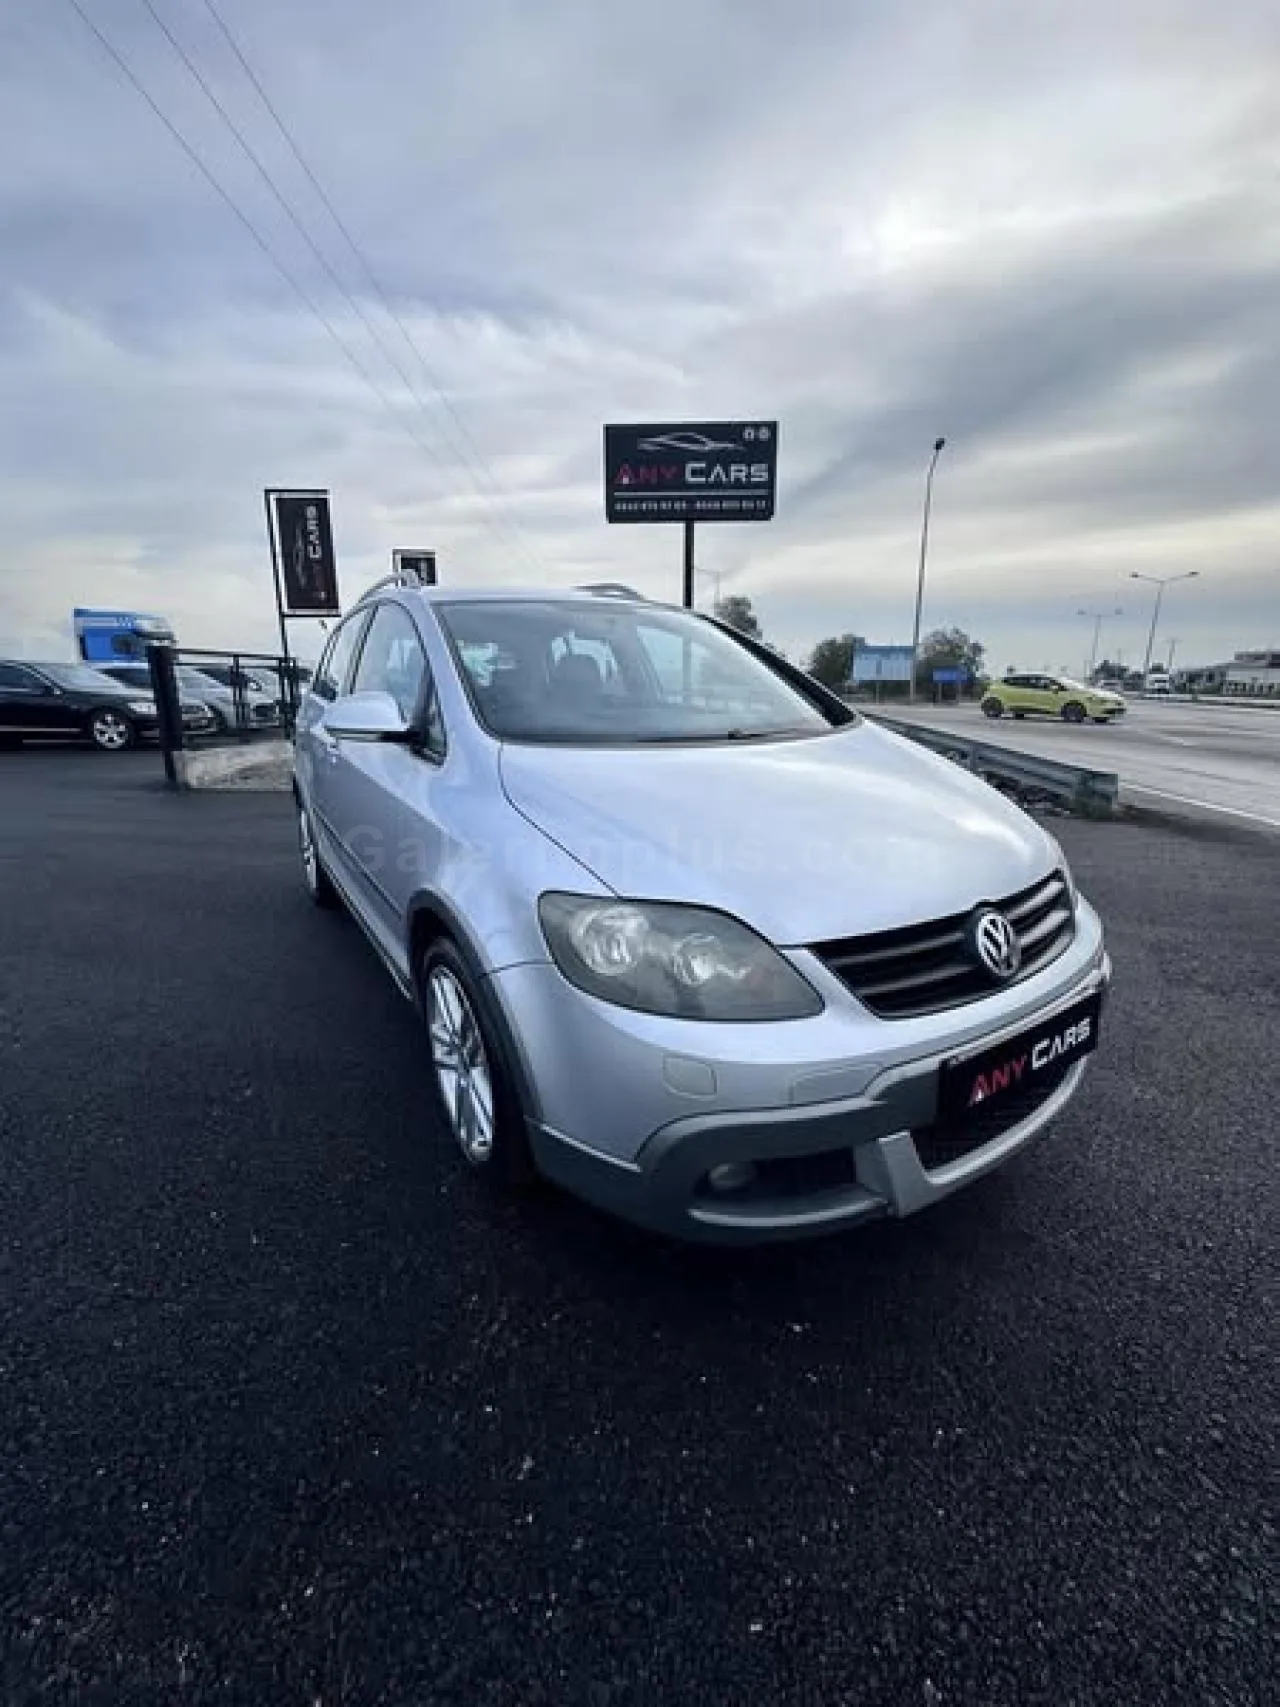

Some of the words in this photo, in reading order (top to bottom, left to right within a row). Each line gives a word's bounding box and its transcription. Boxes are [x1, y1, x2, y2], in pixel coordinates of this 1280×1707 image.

[614, 462, 679, 484] ANY
[685, 461, 769, 484] CARS
[968, 1053, 1028, 1107] ANY
[1032, 1017, 1091, 1071] CARS
